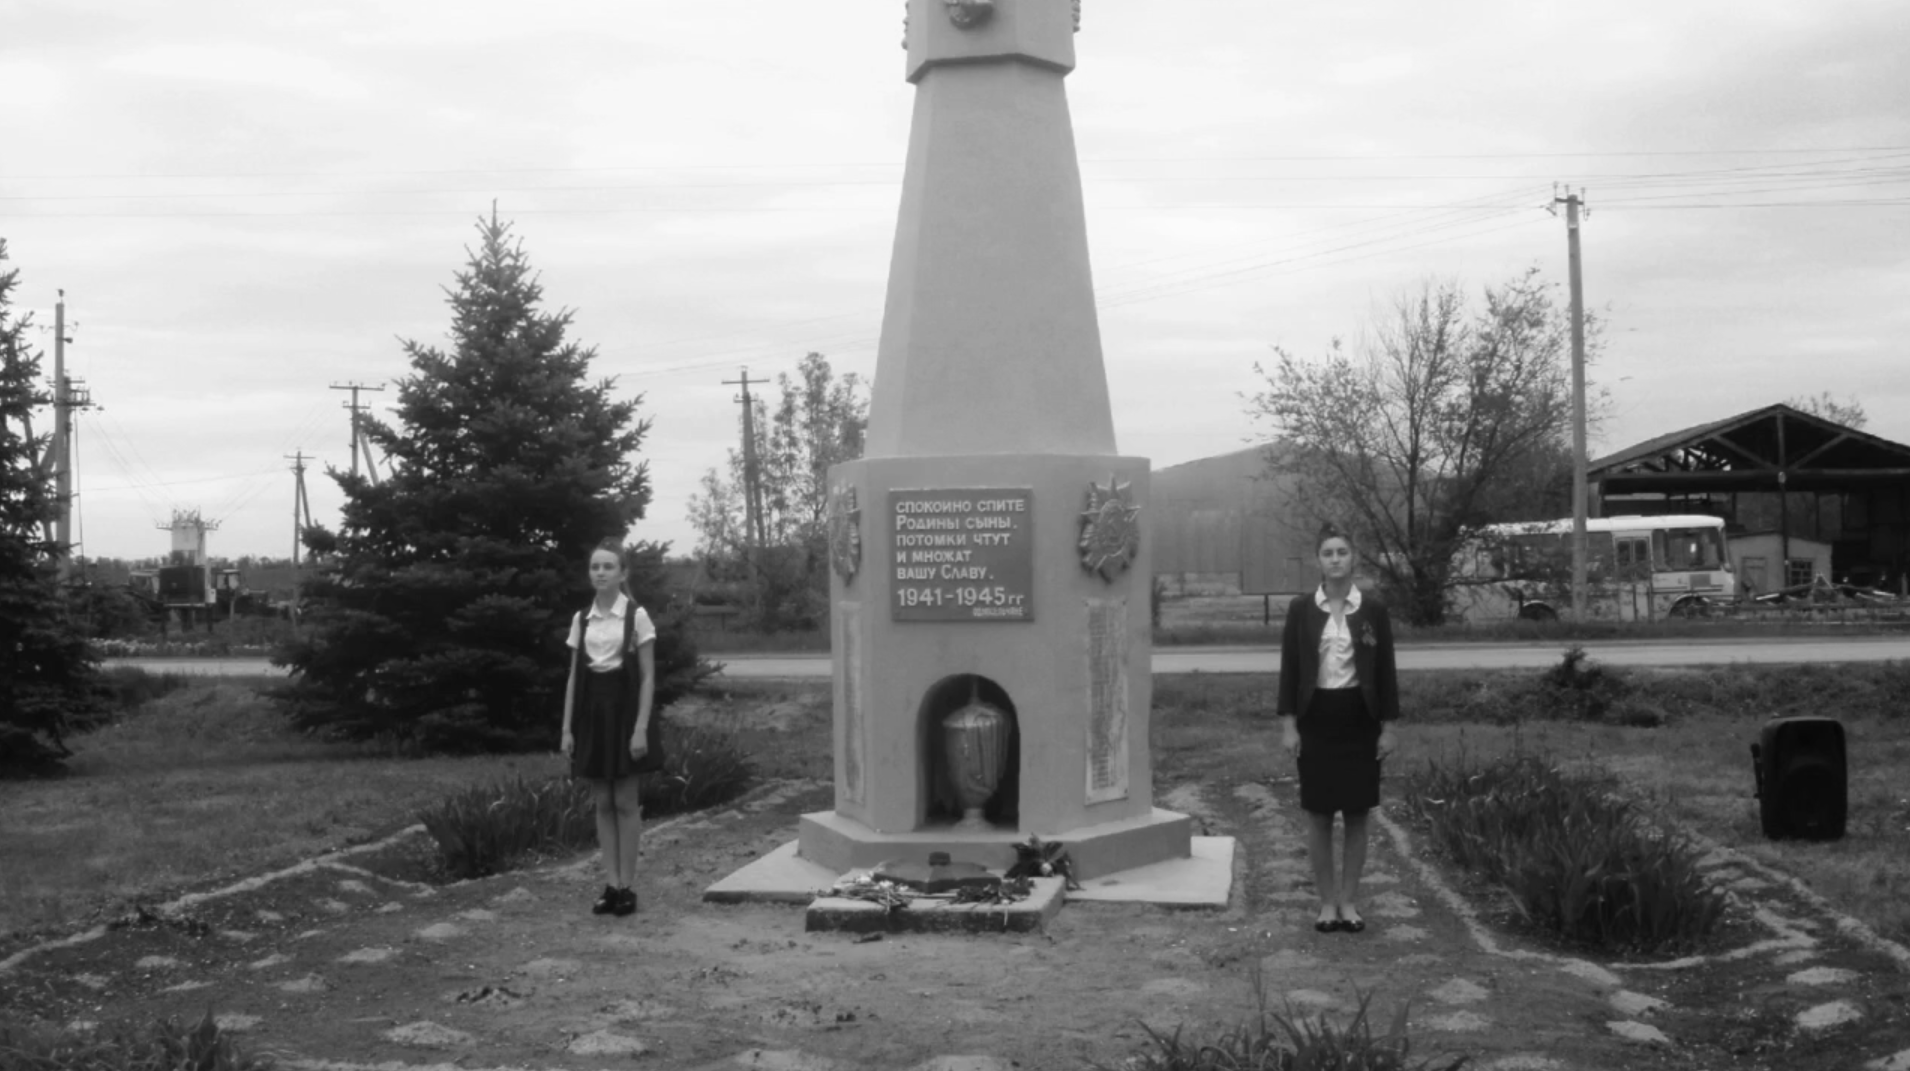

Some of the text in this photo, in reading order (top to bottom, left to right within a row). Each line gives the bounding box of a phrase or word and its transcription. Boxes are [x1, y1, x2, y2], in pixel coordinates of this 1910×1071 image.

[977, 499, 1025, 512] СПИТЕ
[896, 532, 1011, 546] ПОТОМКИ ЧТУТ
[896, 549, 972, 563] И МНОЖАТ
[897, 567, 936, 579] ВАШУ
